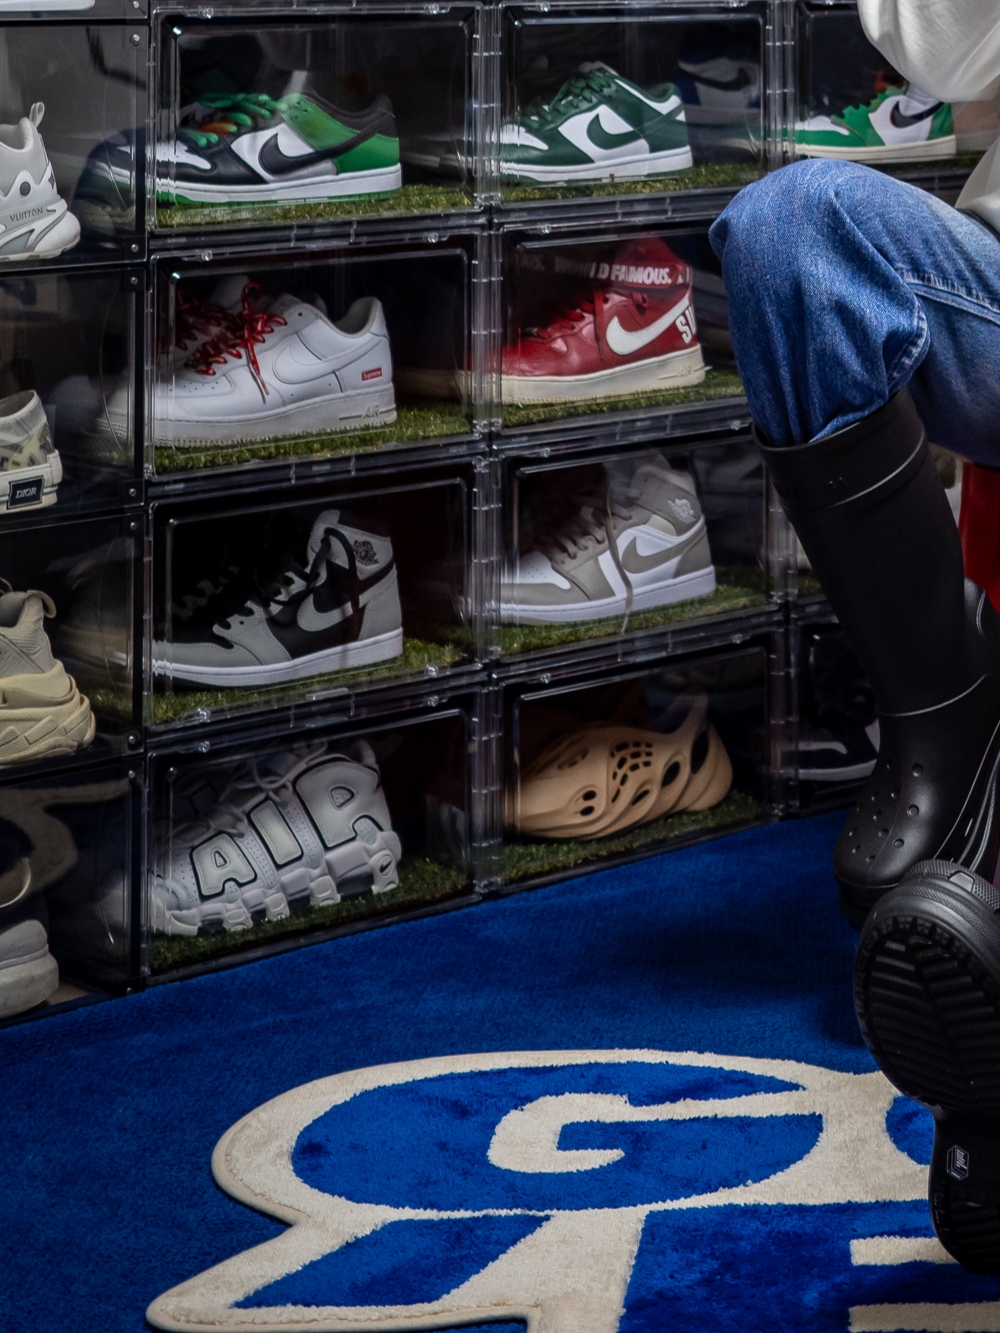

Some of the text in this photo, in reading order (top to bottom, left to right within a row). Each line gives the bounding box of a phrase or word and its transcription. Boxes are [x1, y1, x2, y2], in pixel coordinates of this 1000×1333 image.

[10, 207, 43, 222] VUITTON
[611, 264, 672, 286] FAMOUS.
[15, 488, 37, 499] DIOR
[190, 755, 388, 899] AIR
